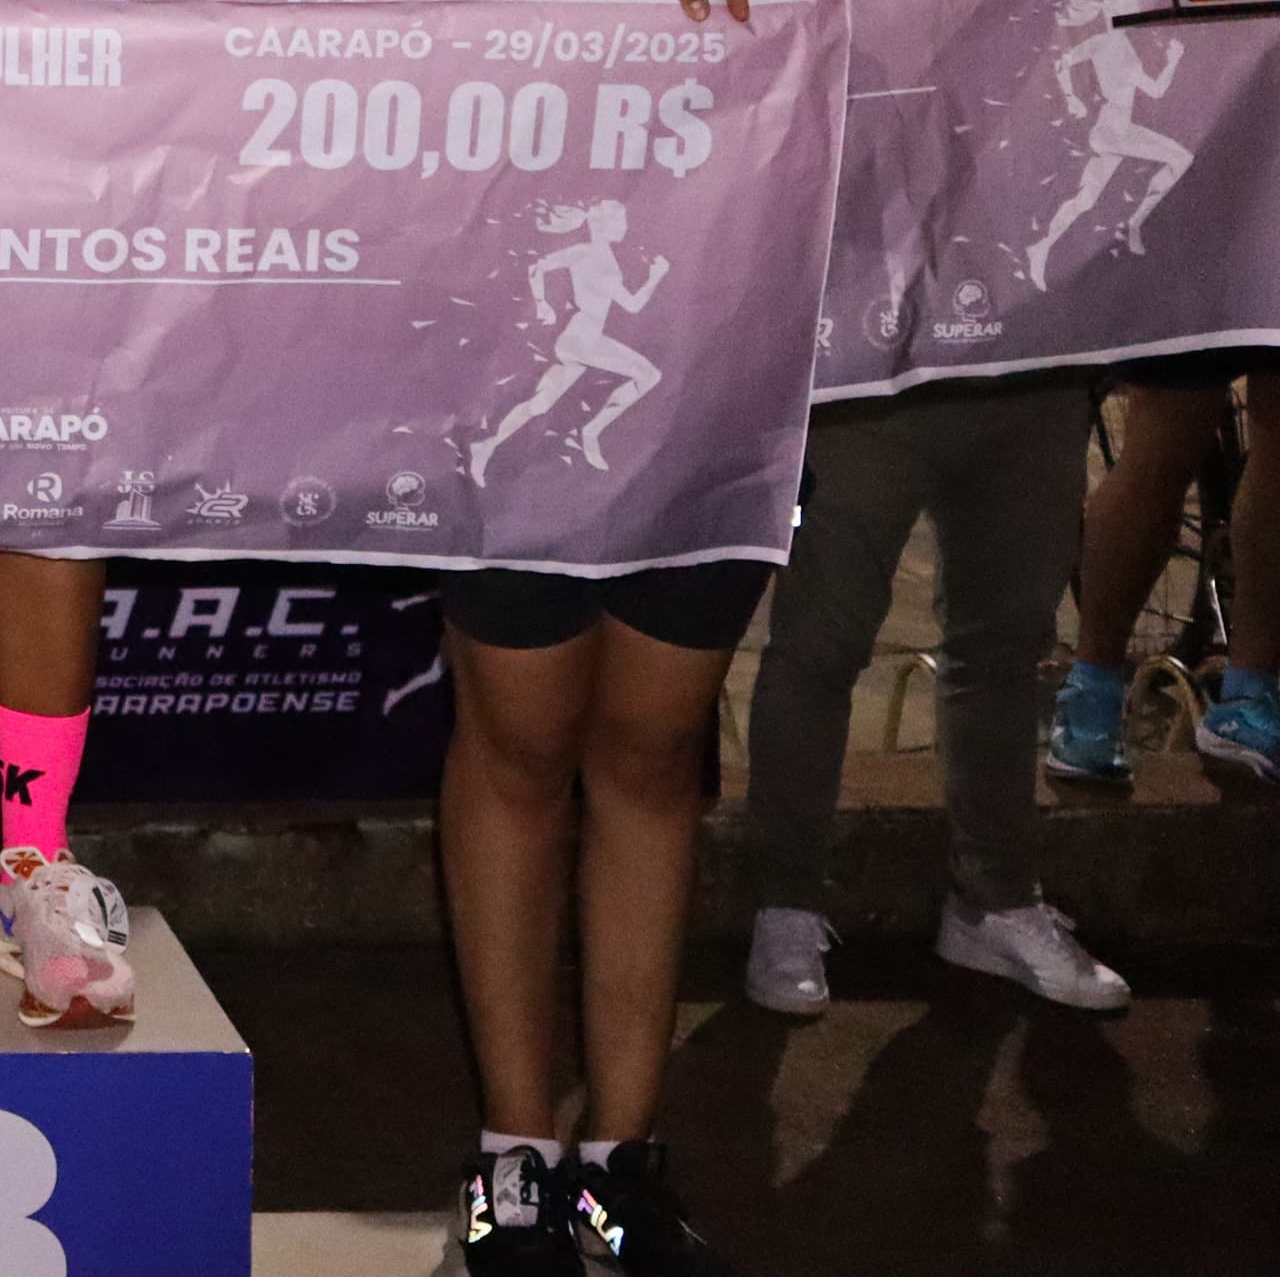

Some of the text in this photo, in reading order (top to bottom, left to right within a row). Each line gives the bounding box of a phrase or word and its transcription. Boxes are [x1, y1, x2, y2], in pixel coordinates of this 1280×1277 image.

[224, 22, 433, 61] CAARAPÓ
[483, 22, 726, 69] 29/03/2025
[238, 76, 716, 179] 200,00 R$
[183, 227, 362, 275] REAIS
[931, 321, 1003, 341] SUPERAR
[2, 503, 84, 521] Romana
[365, 510, 440, 527] SUPERAR
[108, 644, 363, 662] UNNERS
[94, 670, 204, 690] SOCIAÇÃO
[93, 690, 361, 717] AARAPOENSE
